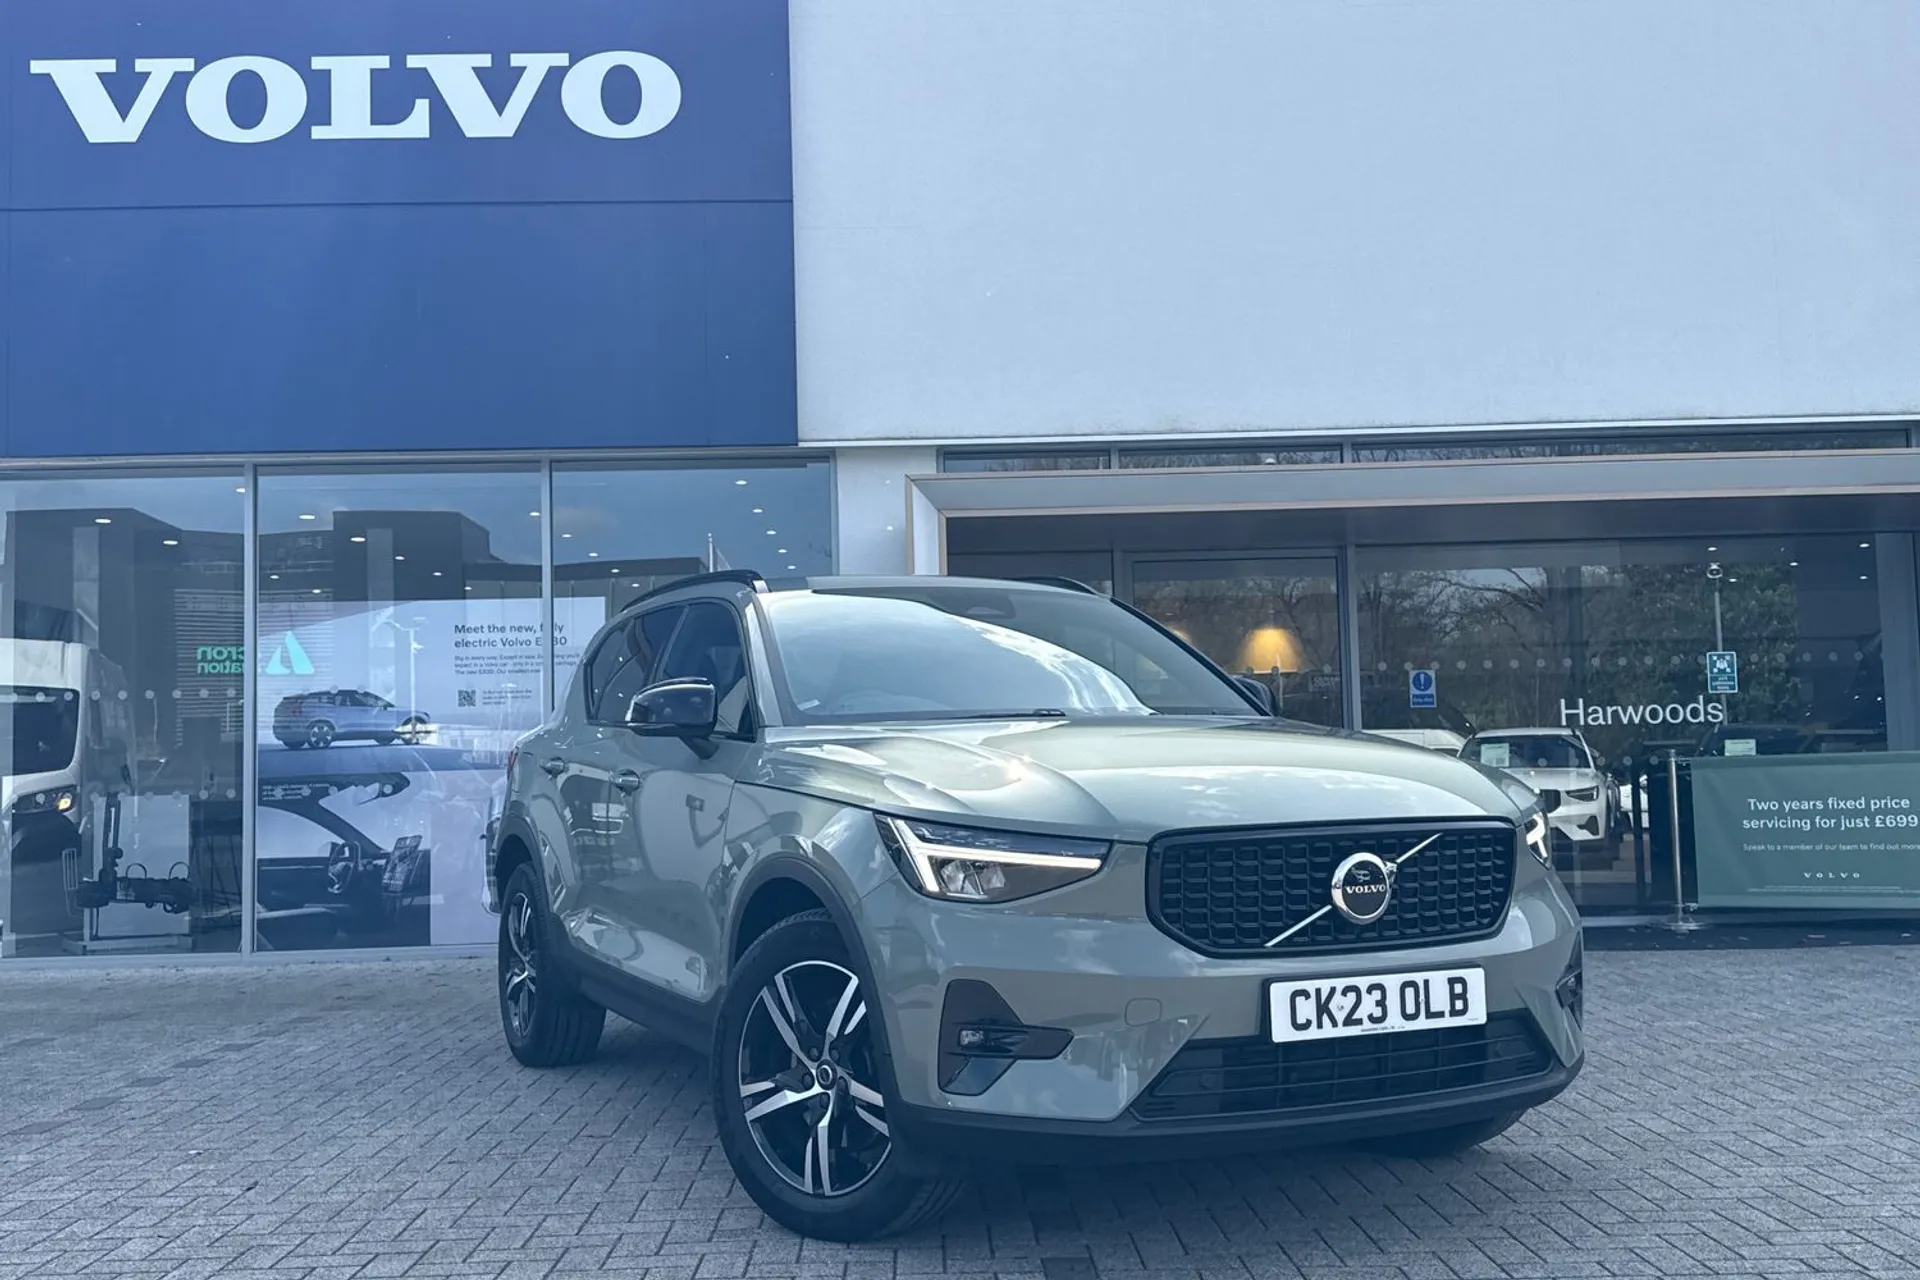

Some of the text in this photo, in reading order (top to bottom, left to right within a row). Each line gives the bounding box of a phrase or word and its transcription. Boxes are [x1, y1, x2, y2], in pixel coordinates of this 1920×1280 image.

[30, 51, 681, 143] VOLVO
[454, 622, 564, 634] Meet the new, fly
[454, 636, 567, 648] electric Volvo E30
[1560, 695, 1724, 726] Harwoods
[1747, 796, 1910, 812] Two years fixed price
[1743, 814, 1919, 831] servicing for just £699
[1743, 843, 1766, 851] Speak
[1345, 884, 1386, 894] VOLVO
[1289, 976, 1470, 1032] CK23 OLB
